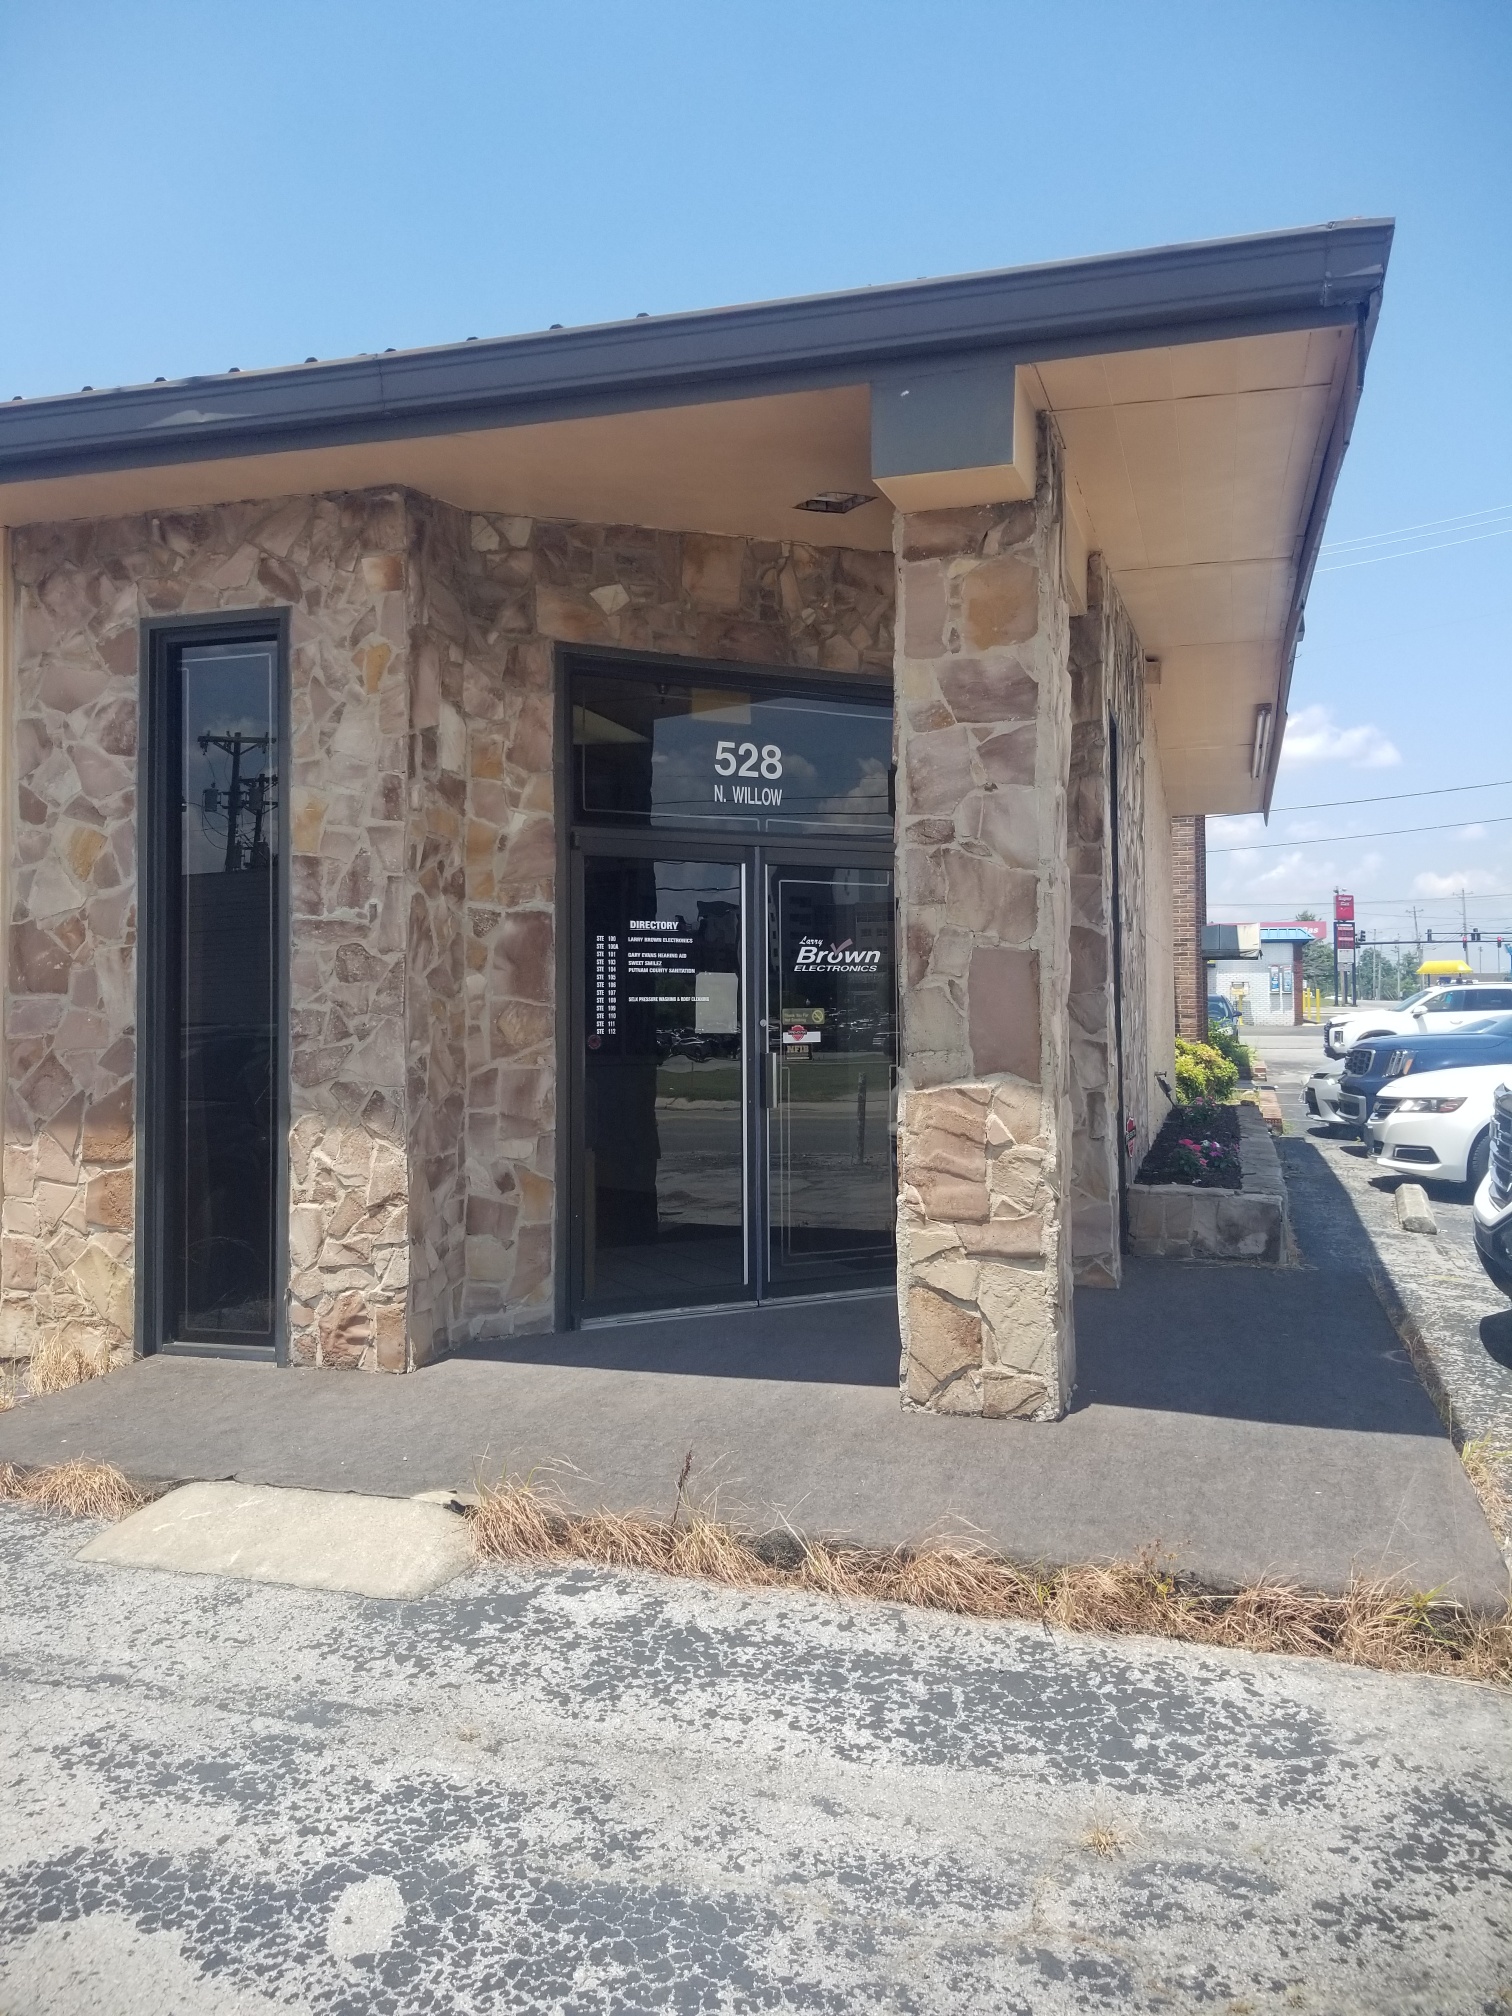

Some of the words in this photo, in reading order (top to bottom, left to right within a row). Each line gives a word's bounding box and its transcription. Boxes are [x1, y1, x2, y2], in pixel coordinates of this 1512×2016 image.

[714, 740, 783, 780] 528
[714, 784, 726, 802] N.
[732, 786, 782, 806] WILLOW
[630, 920, 679, 930] DIRECTORY
[798, 935, 824, 947] Larry
[796, 946, 881, 964] Brown
